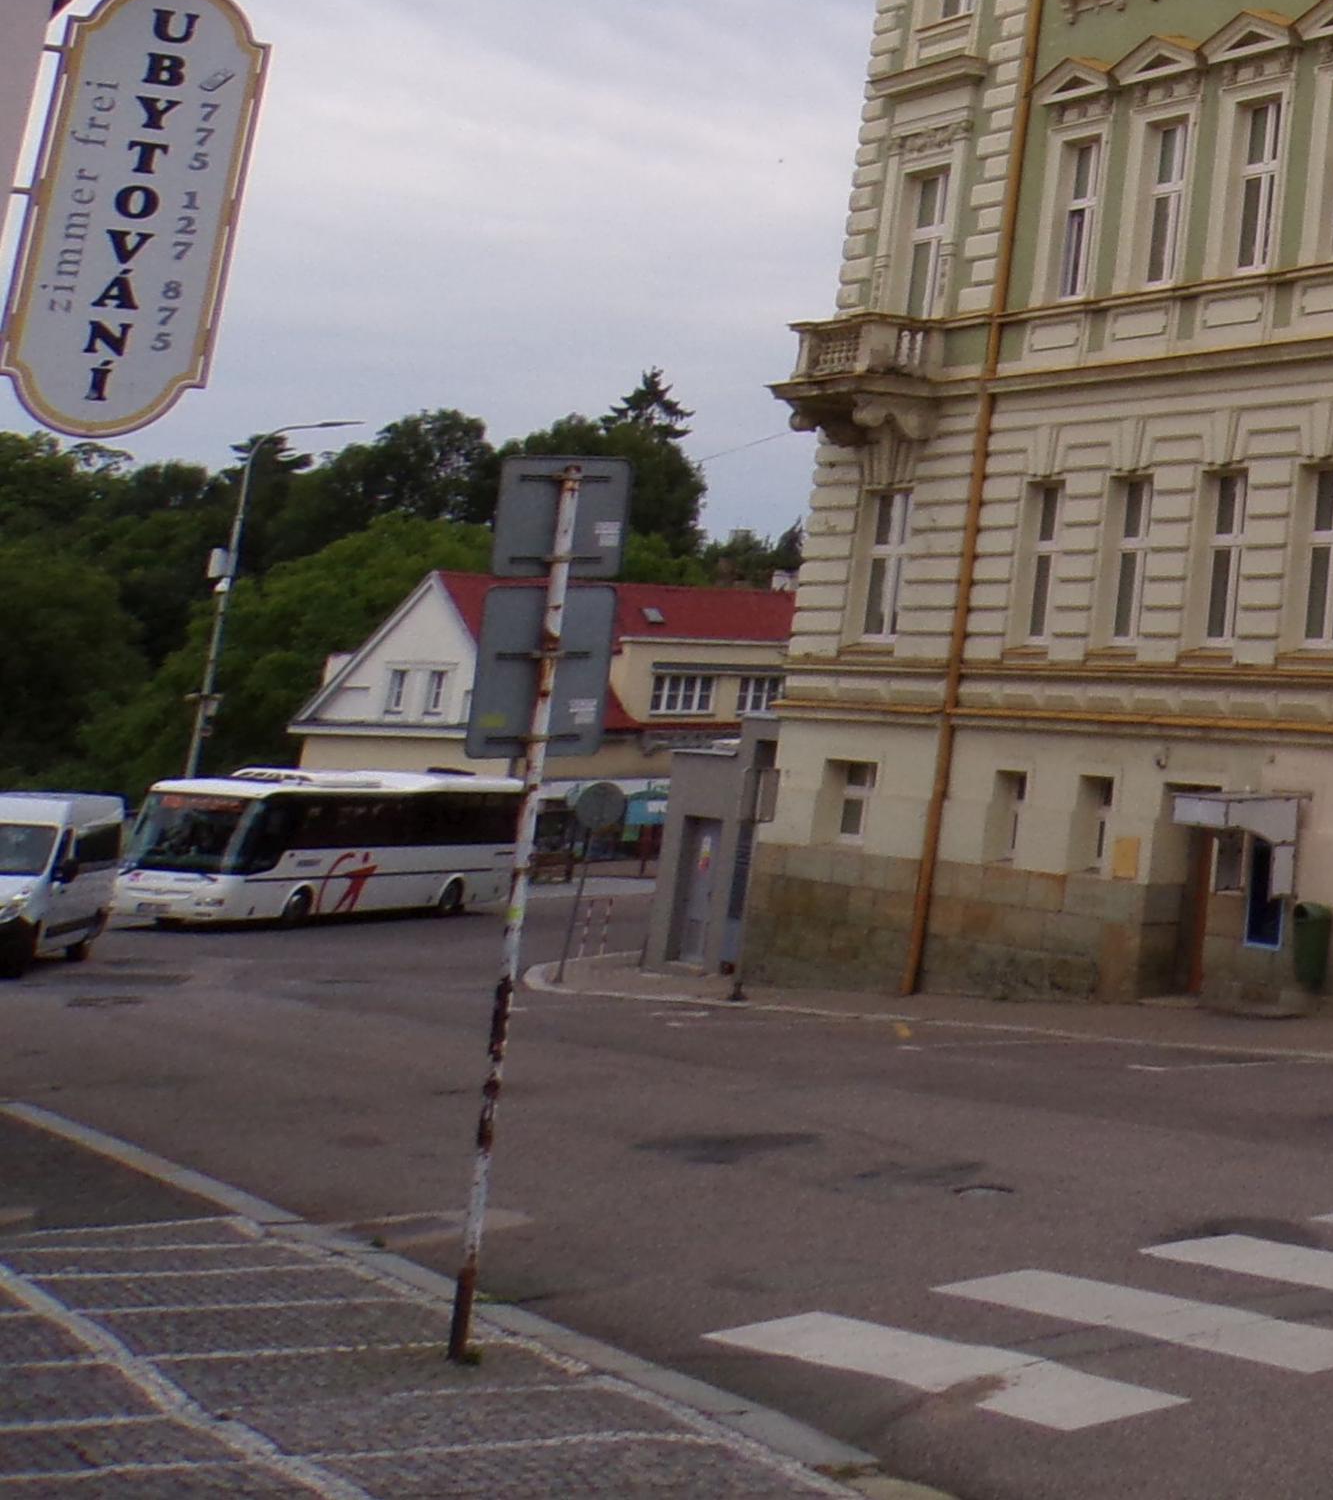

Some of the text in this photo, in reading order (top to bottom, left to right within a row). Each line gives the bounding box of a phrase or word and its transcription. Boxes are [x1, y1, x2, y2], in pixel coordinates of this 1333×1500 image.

[41, 81, 119, 313] zimmer frei
[83, 9, 200, 401] UBYTOVÁNÍ
[150, 103, 220, 352] 775 127 875
